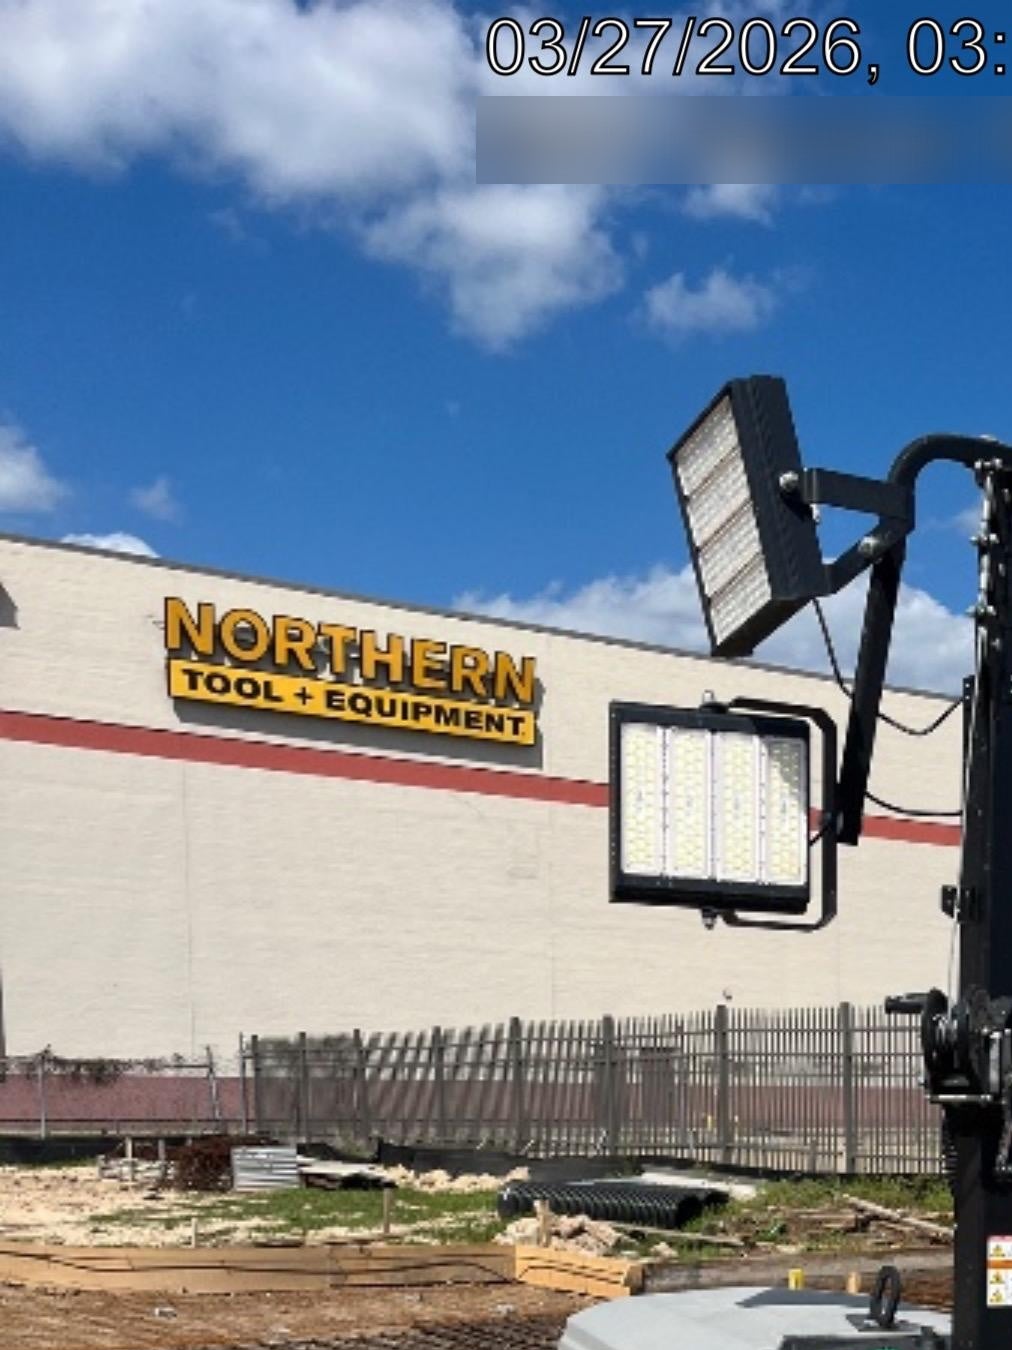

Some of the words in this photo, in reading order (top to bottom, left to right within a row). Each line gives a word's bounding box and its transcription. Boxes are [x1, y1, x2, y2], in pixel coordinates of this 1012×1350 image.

[164, 596, 536, 704] NORTHERN
[182, 668, 284, 703] TOOL
[325, 689, 526, 737] EQUIPMENT
